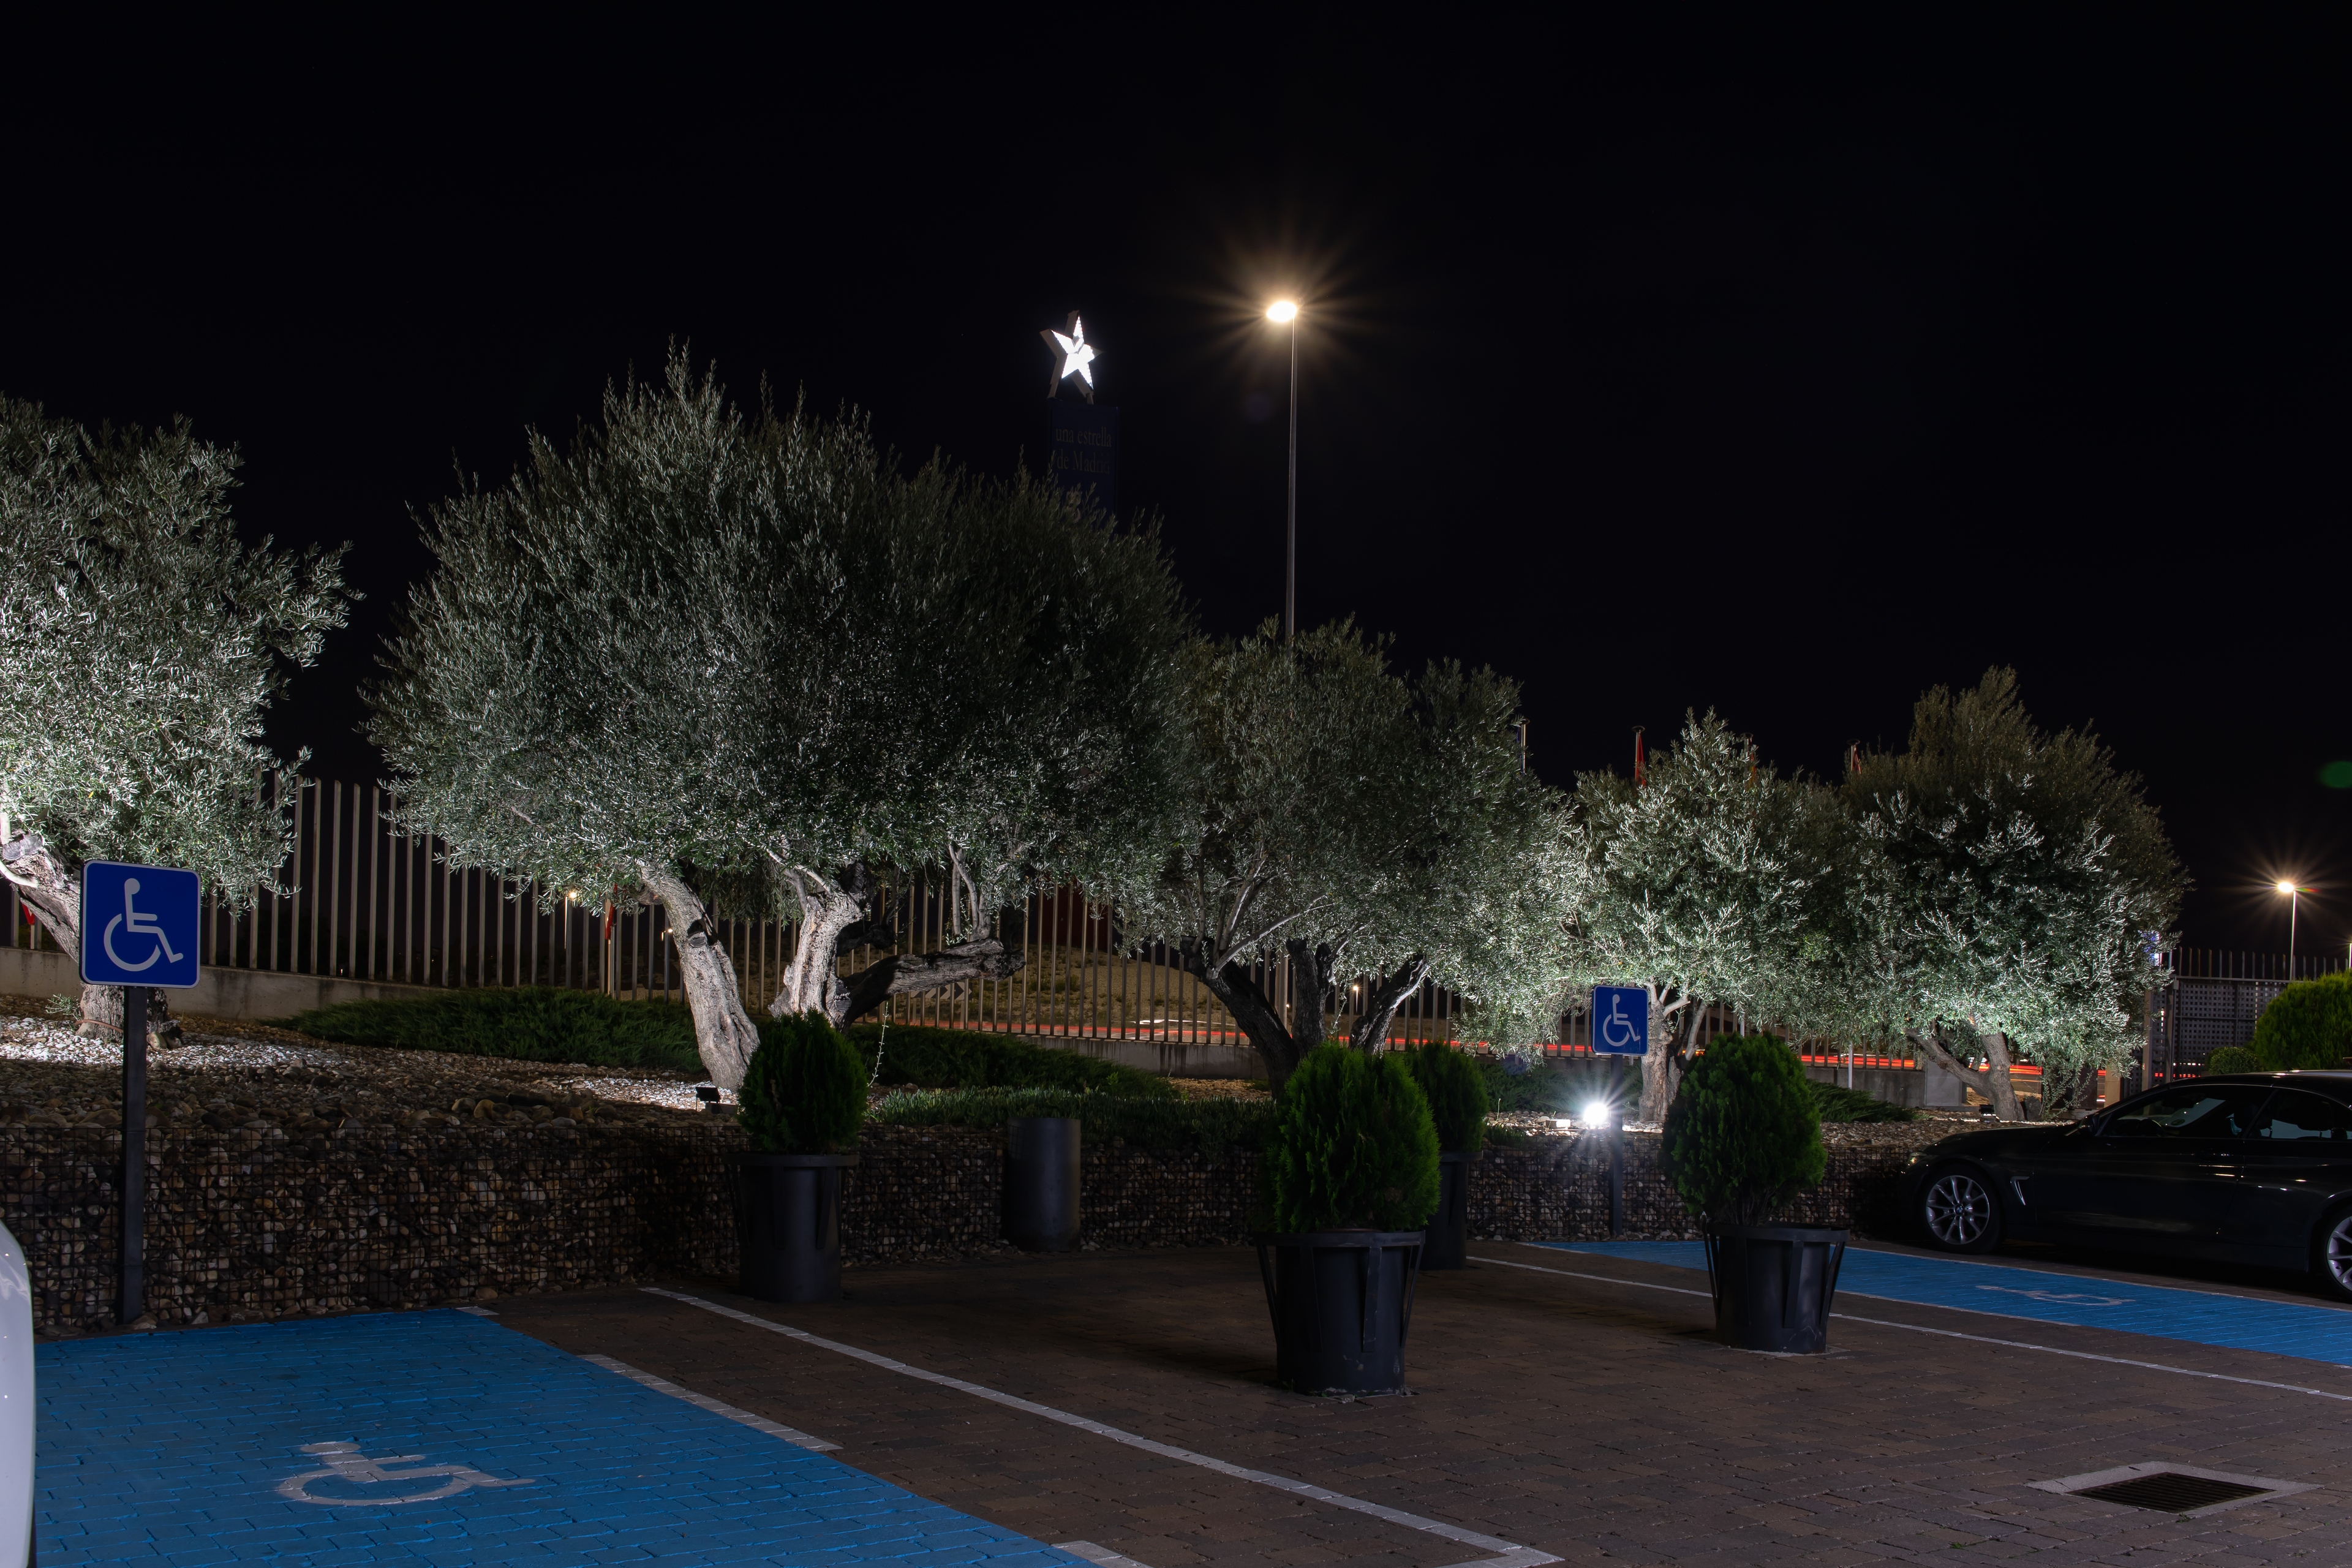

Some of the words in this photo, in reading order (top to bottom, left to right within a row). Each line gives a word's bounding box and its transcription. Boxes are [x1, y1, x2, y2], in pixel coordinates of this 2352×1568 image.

[1056, 429, 1074, 443] una
[1077, 427, 1112, 447] estrella
[1057, 449, 1069, 469] de
[1072, 451, 1110, 473] Madrid
